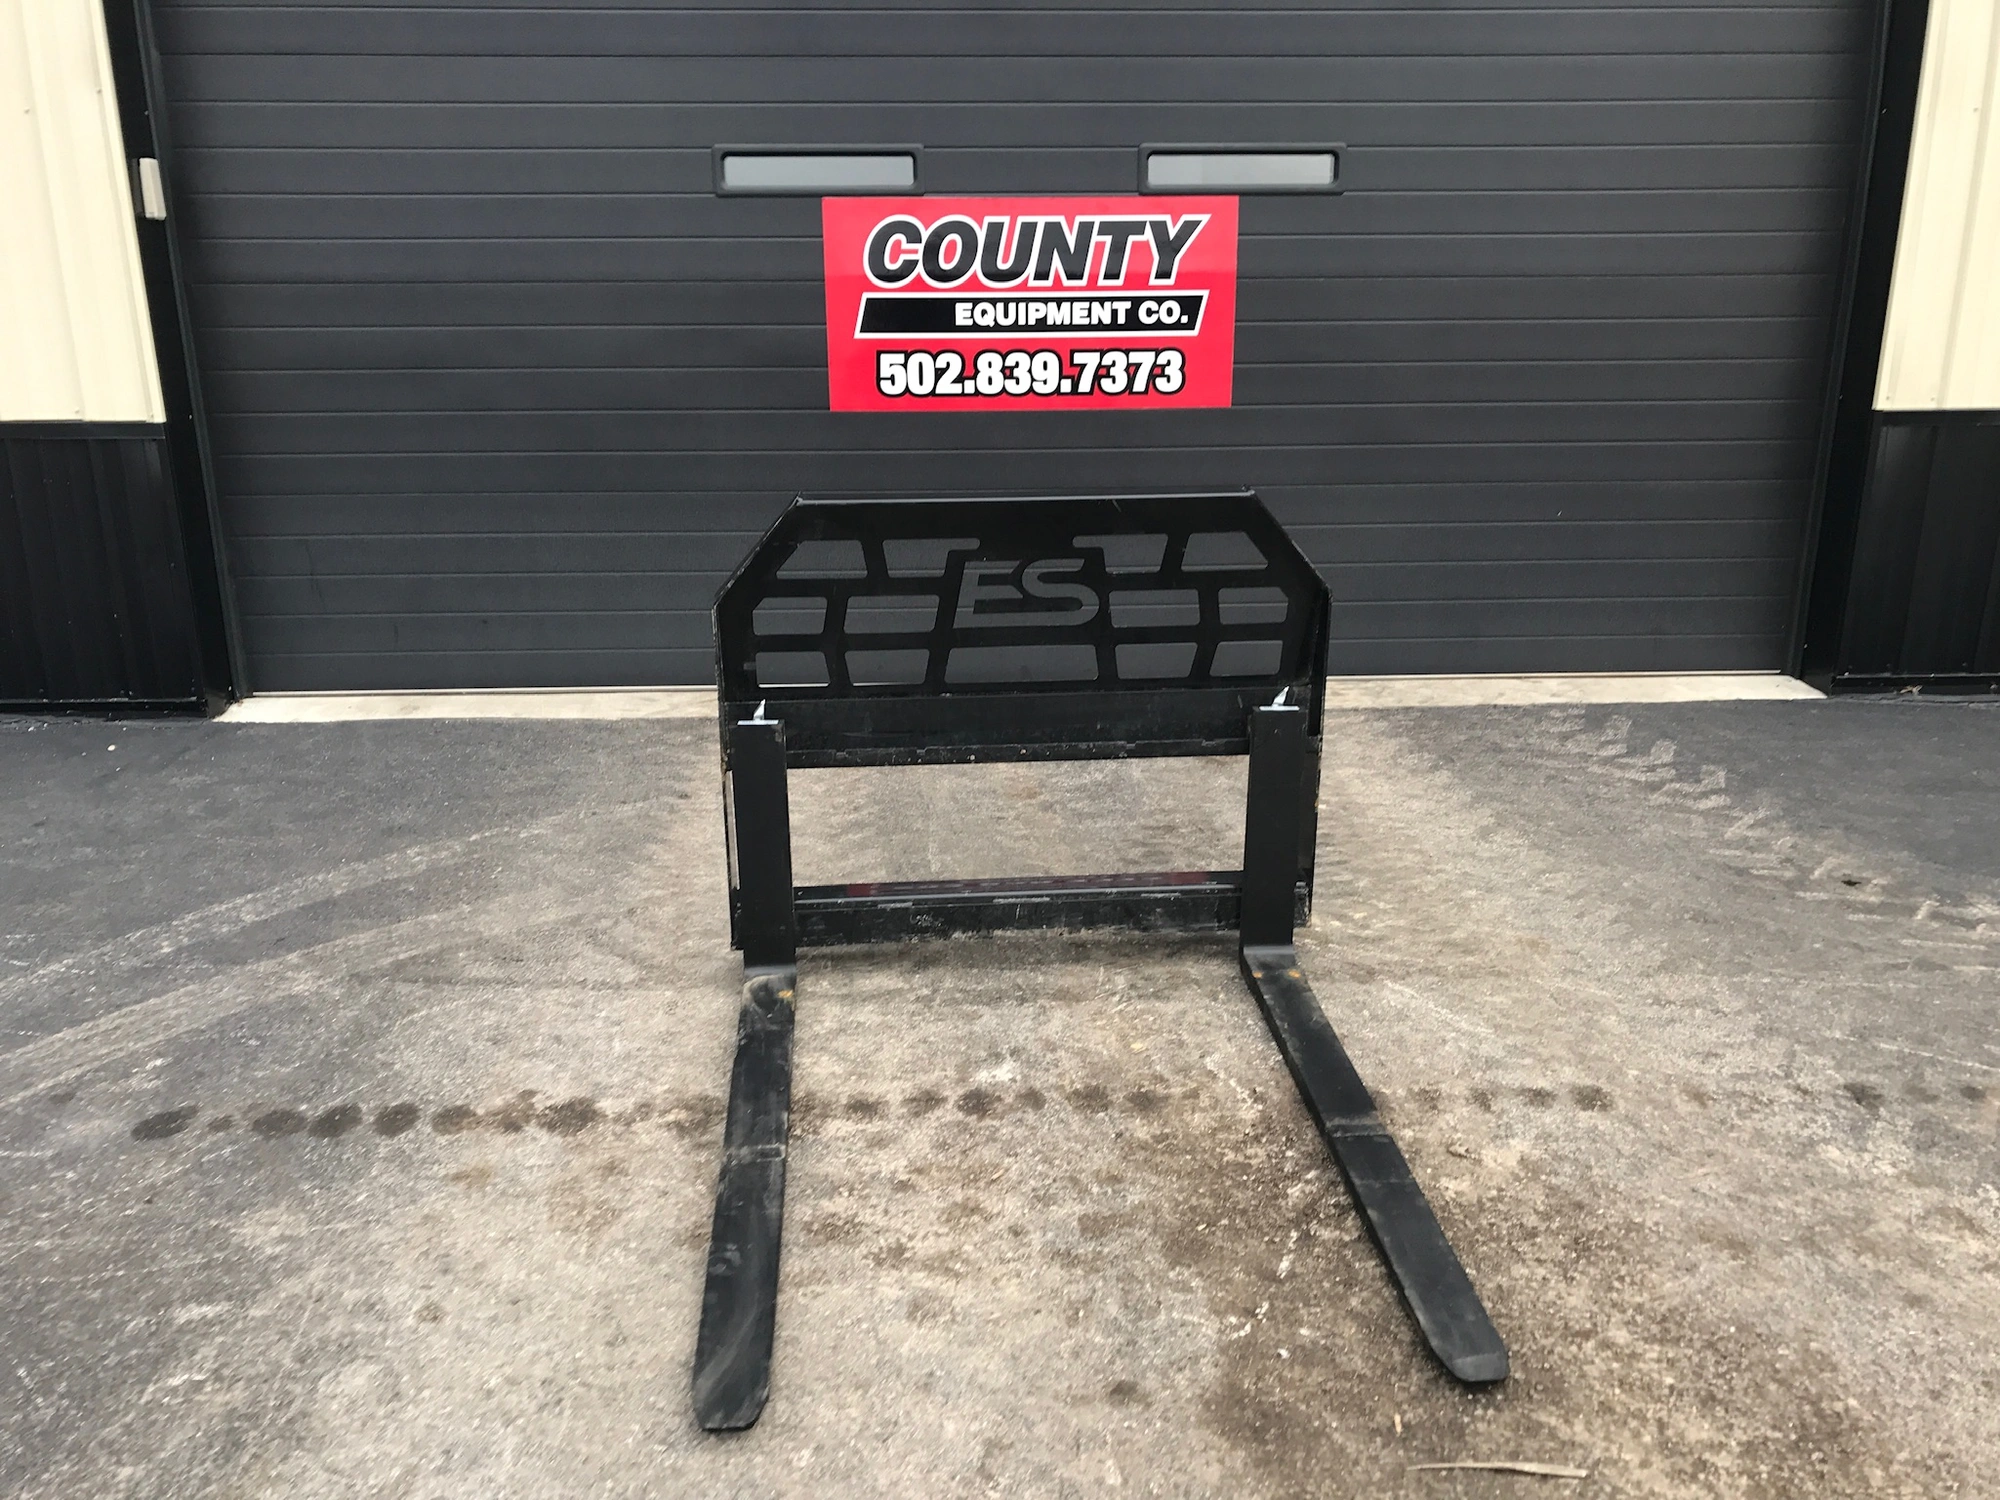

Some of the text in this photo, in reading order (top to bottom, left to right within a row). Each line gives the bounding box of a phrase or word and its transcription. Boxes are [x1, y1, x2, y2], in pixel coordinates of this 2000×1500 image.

[863, 213, 1211, 289] COUNTY
[954, 300, 1189, 328] EQUIPMENT CO.
[876, 349, 1186, 396] 502.839.7373
